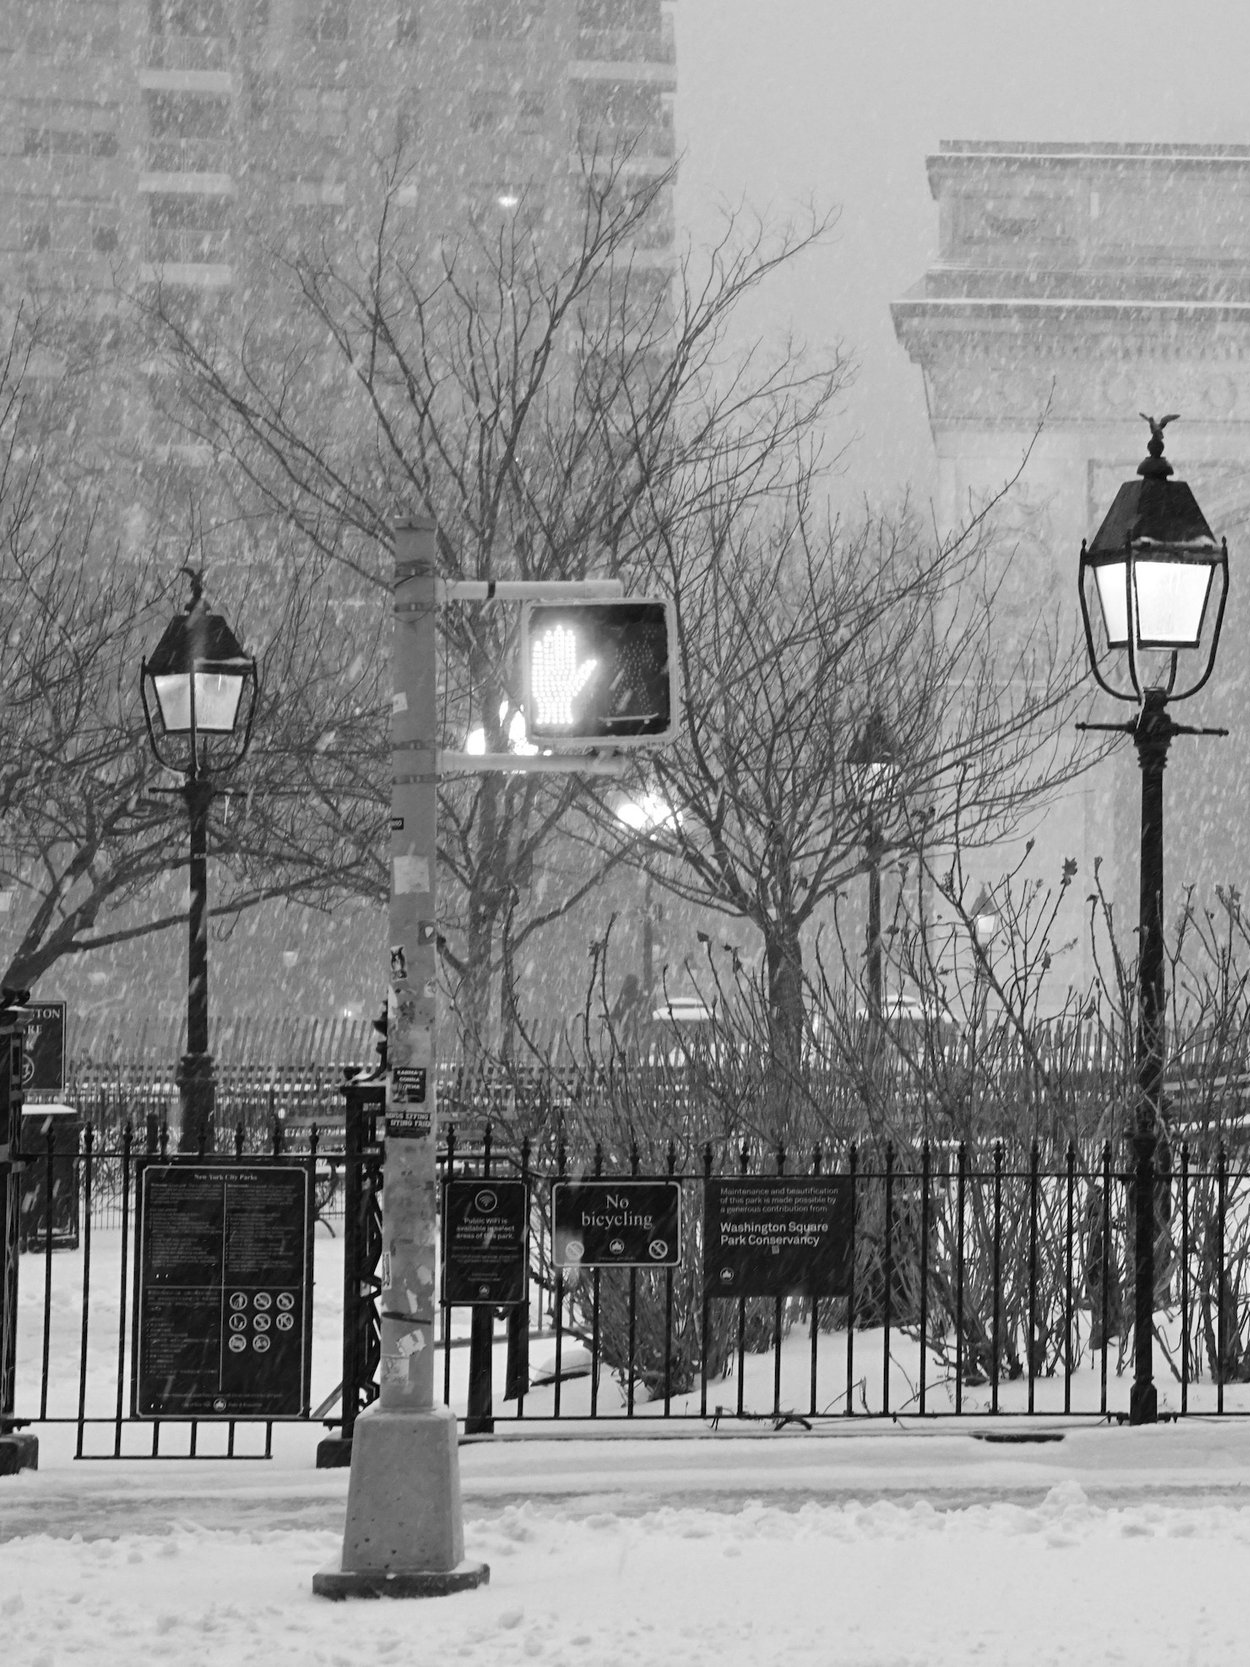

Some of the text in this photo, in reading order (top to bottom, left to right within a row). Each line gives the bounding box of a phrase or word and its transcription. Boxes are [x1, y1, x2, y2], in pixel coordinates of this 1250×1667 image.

[194, 1173, 258, 1182] New York City Parks
[720, 1187, 839, 1196] Maintenance and beautification
[606, 1194, 630, 1209] No
[729, 1196, 744, 1204] this
[745, 1197, 762, 1207] park
[794, 1197, 826, 1206] possible
[827, 1196, 837, 1206] by
[727, 1206, 761, 1215] generous
[762, 1204, 809, 1213] contribution
[810, 1204, 828, 1213] from
[582, 1211, 653, 1230] bicycling
[720, 1221, 829, 1235] Washington Square
[720, 1234, 820, 1247] Park Conservancy
